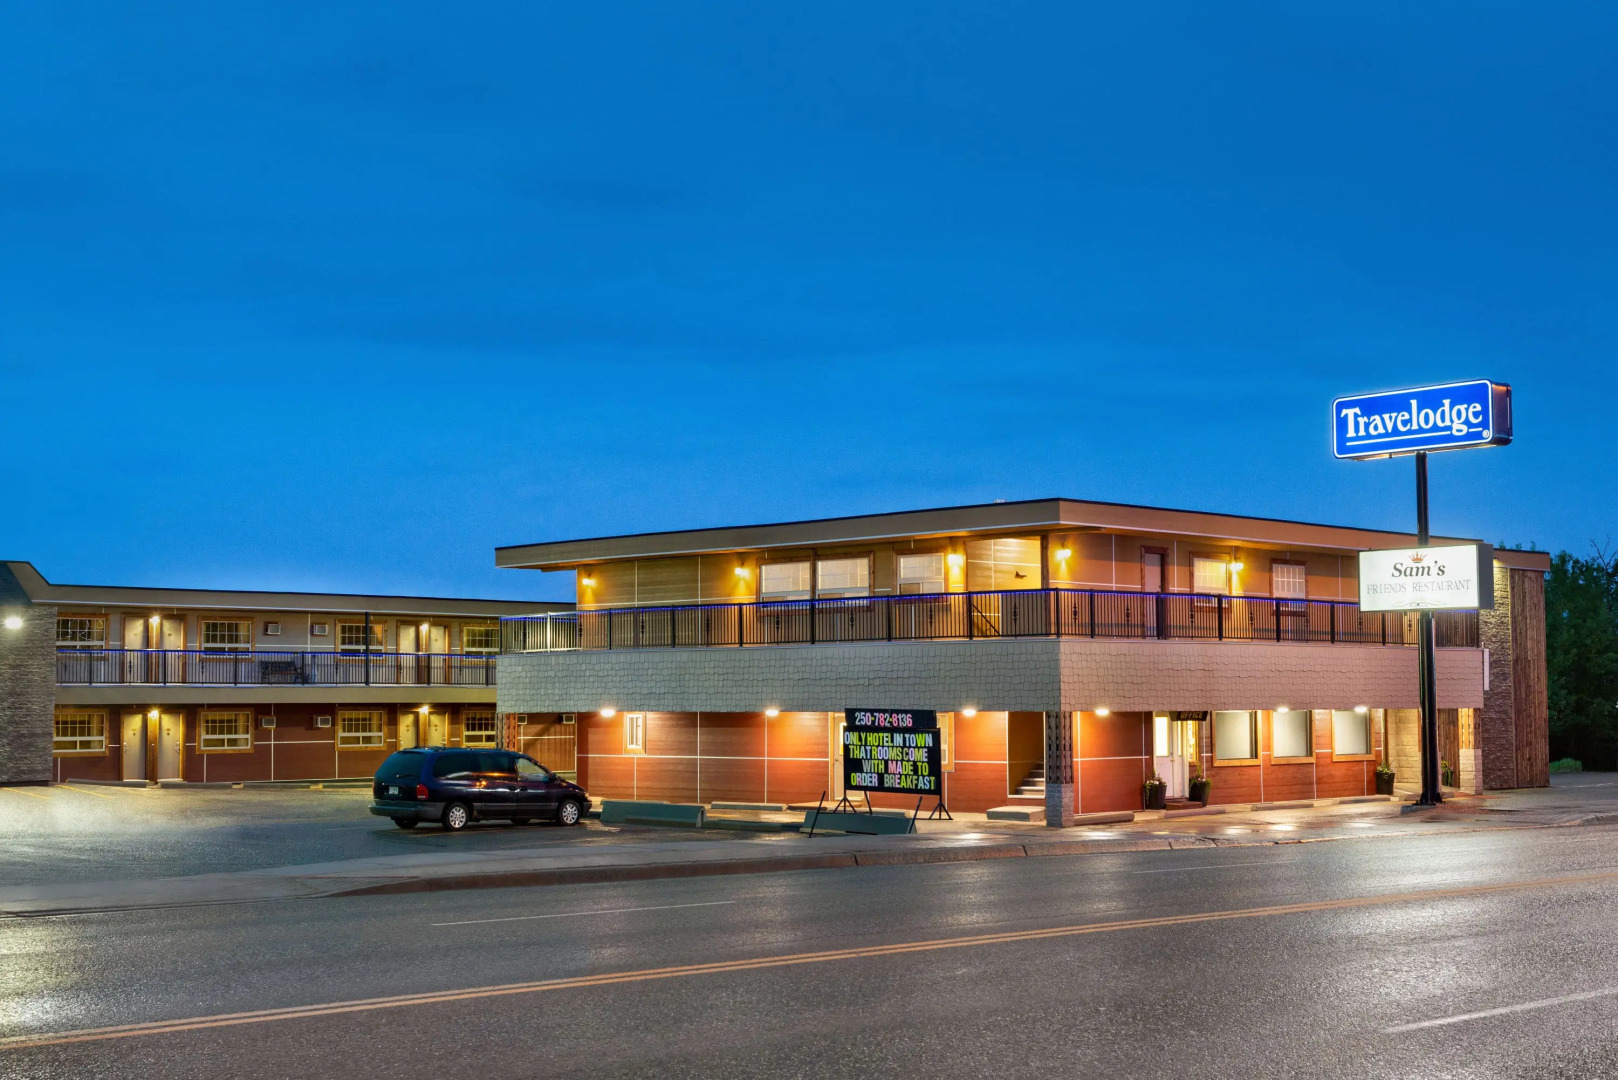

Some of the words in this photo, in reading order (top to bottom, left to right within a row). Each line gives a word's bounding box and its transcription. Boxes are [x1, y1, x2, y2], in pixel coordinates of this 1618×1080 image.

[1341, 399, 1483, 436] Travelodge
[1391, 560, 1446, 578] Sam's
[1366, 582, 1407, 595] FRIENDS
[1412, 580, 1471, 593] RESTAURANT
[1180, 711, 1203, 719] OFFICE
[844, 731, 866, 746] ONLY
[867, 732, 893, 747] HOTEL
[893, 733, 903, 747] IN
[904, 733, 933, 747] TOWN
[849, 745, 871, 759] THAT
[871, 746, 902, 760] ROOMS
[903, 747, 928, 762] COME
[862, 760, 885, 774] WITH
[888, 760, 914, 775] MADE
[917, 761, 929, 776] TO
[850, 772, 878, 787] ORDER
[883, 773, 936, 790] BREAKFAST
